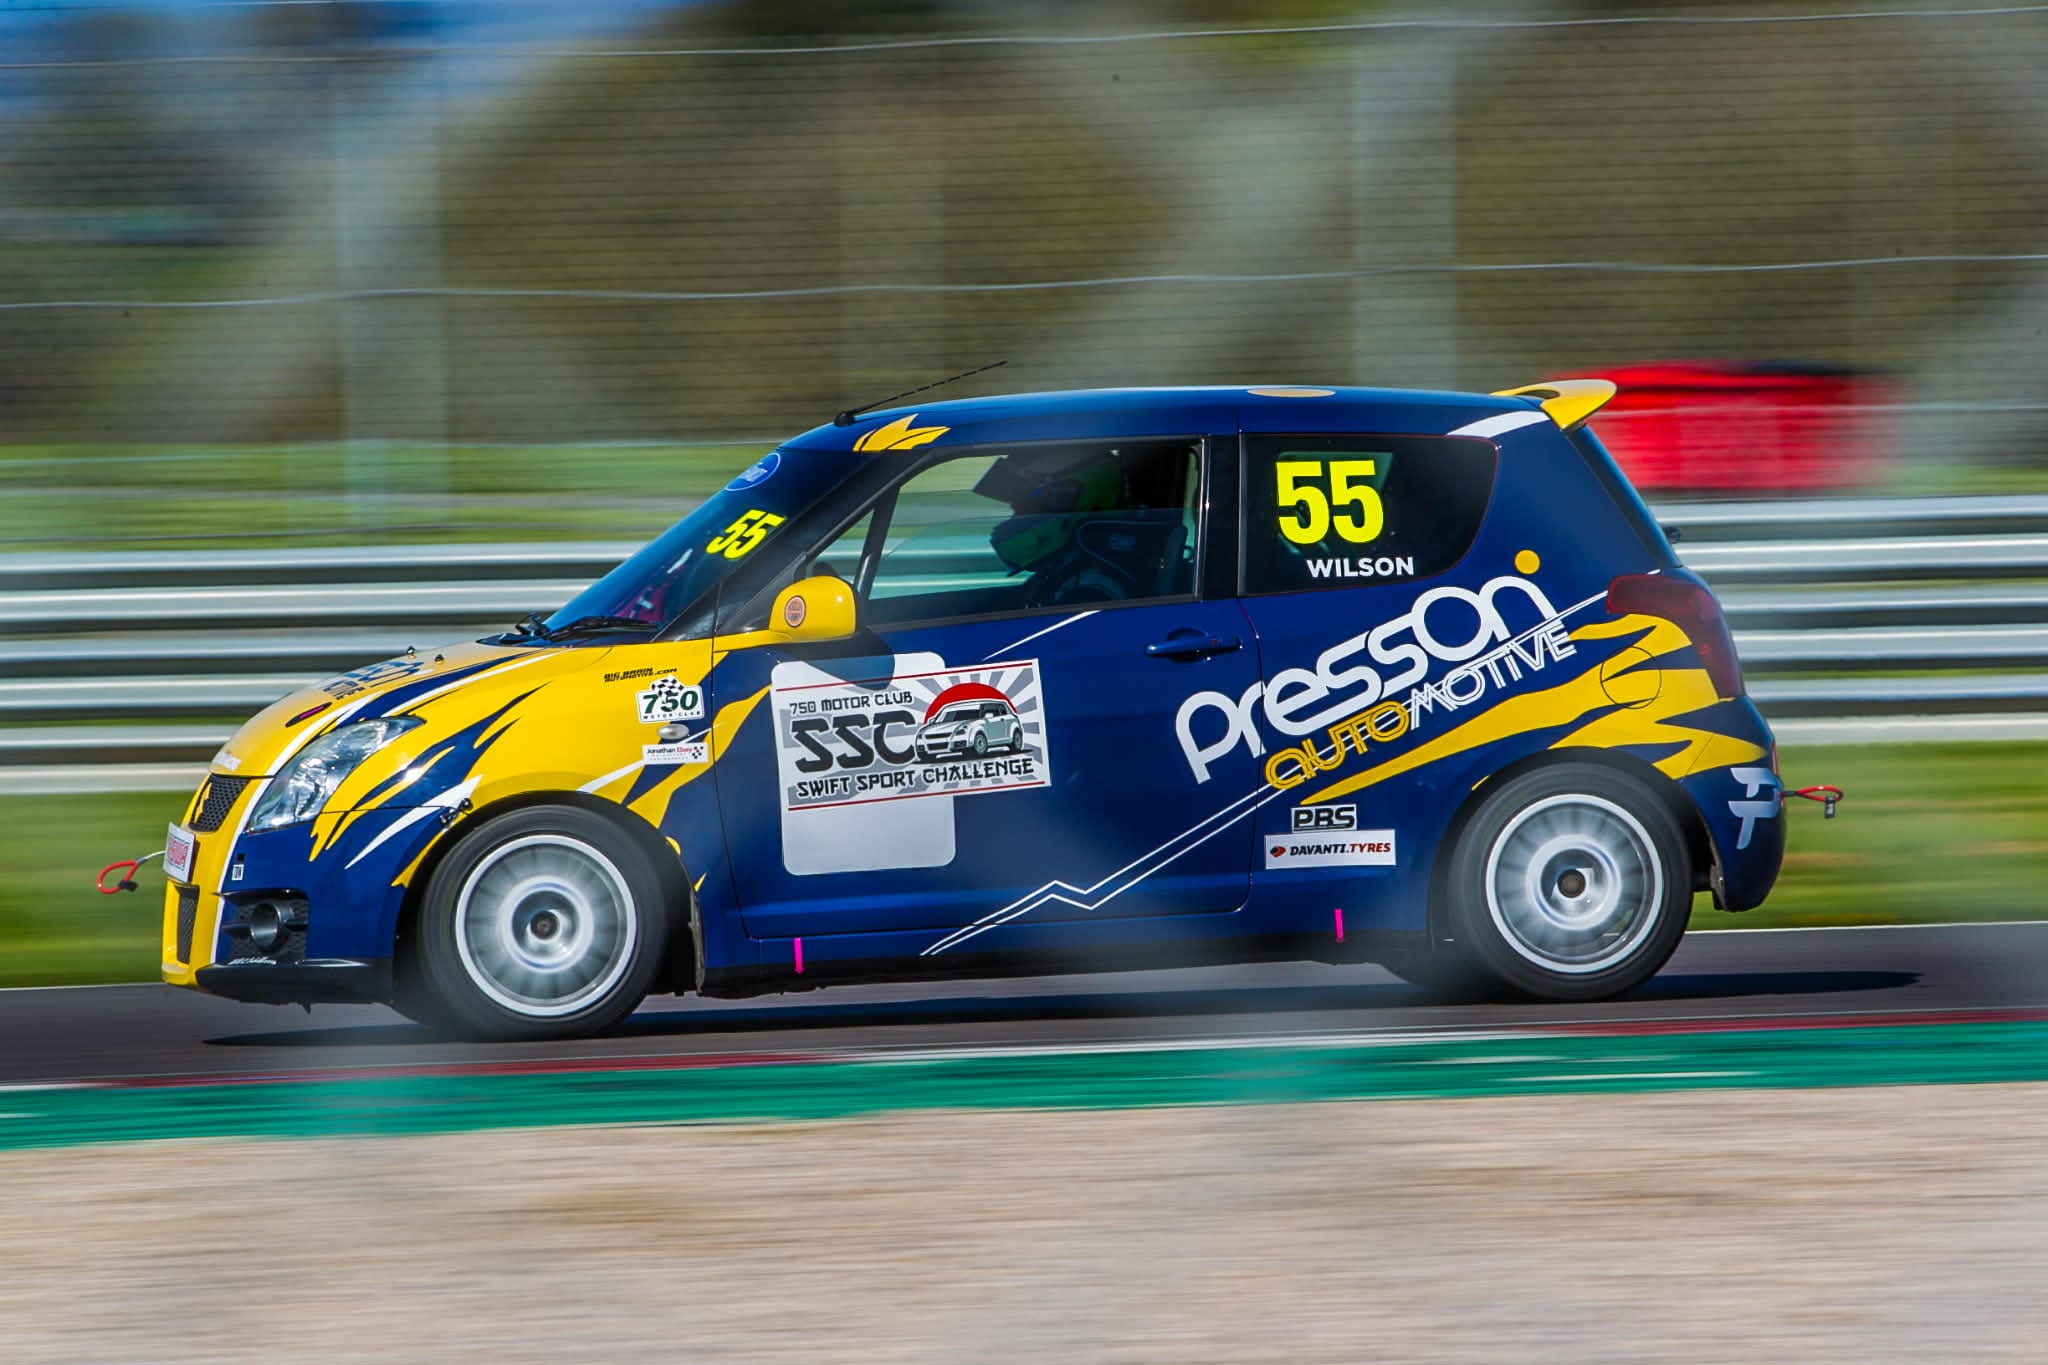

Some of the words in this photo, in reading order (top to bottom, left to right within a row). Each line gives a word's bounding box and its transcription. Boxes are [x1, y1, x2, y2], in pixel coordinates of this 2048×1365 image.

[1276, 460, 1383, 544] 55
[706, 509, 785, 559] 55
[1306, 557, 1414, 578] WILSON
[643, 690, 699, 714] 750
[789, 701, 817, 715] 750
[821, 692, 870, 712] MOTOR
[874, 690, 913, 706] CLUB
[791, 709, 916, 774] SSC
[797, 776, 850, 798] SWIFT
[857, 770, 915, 791] SPORT
[922, 758, 1035, 784] CHALLENGE
[1290, 842, 1391, 856] DAVANTI.TYRES
